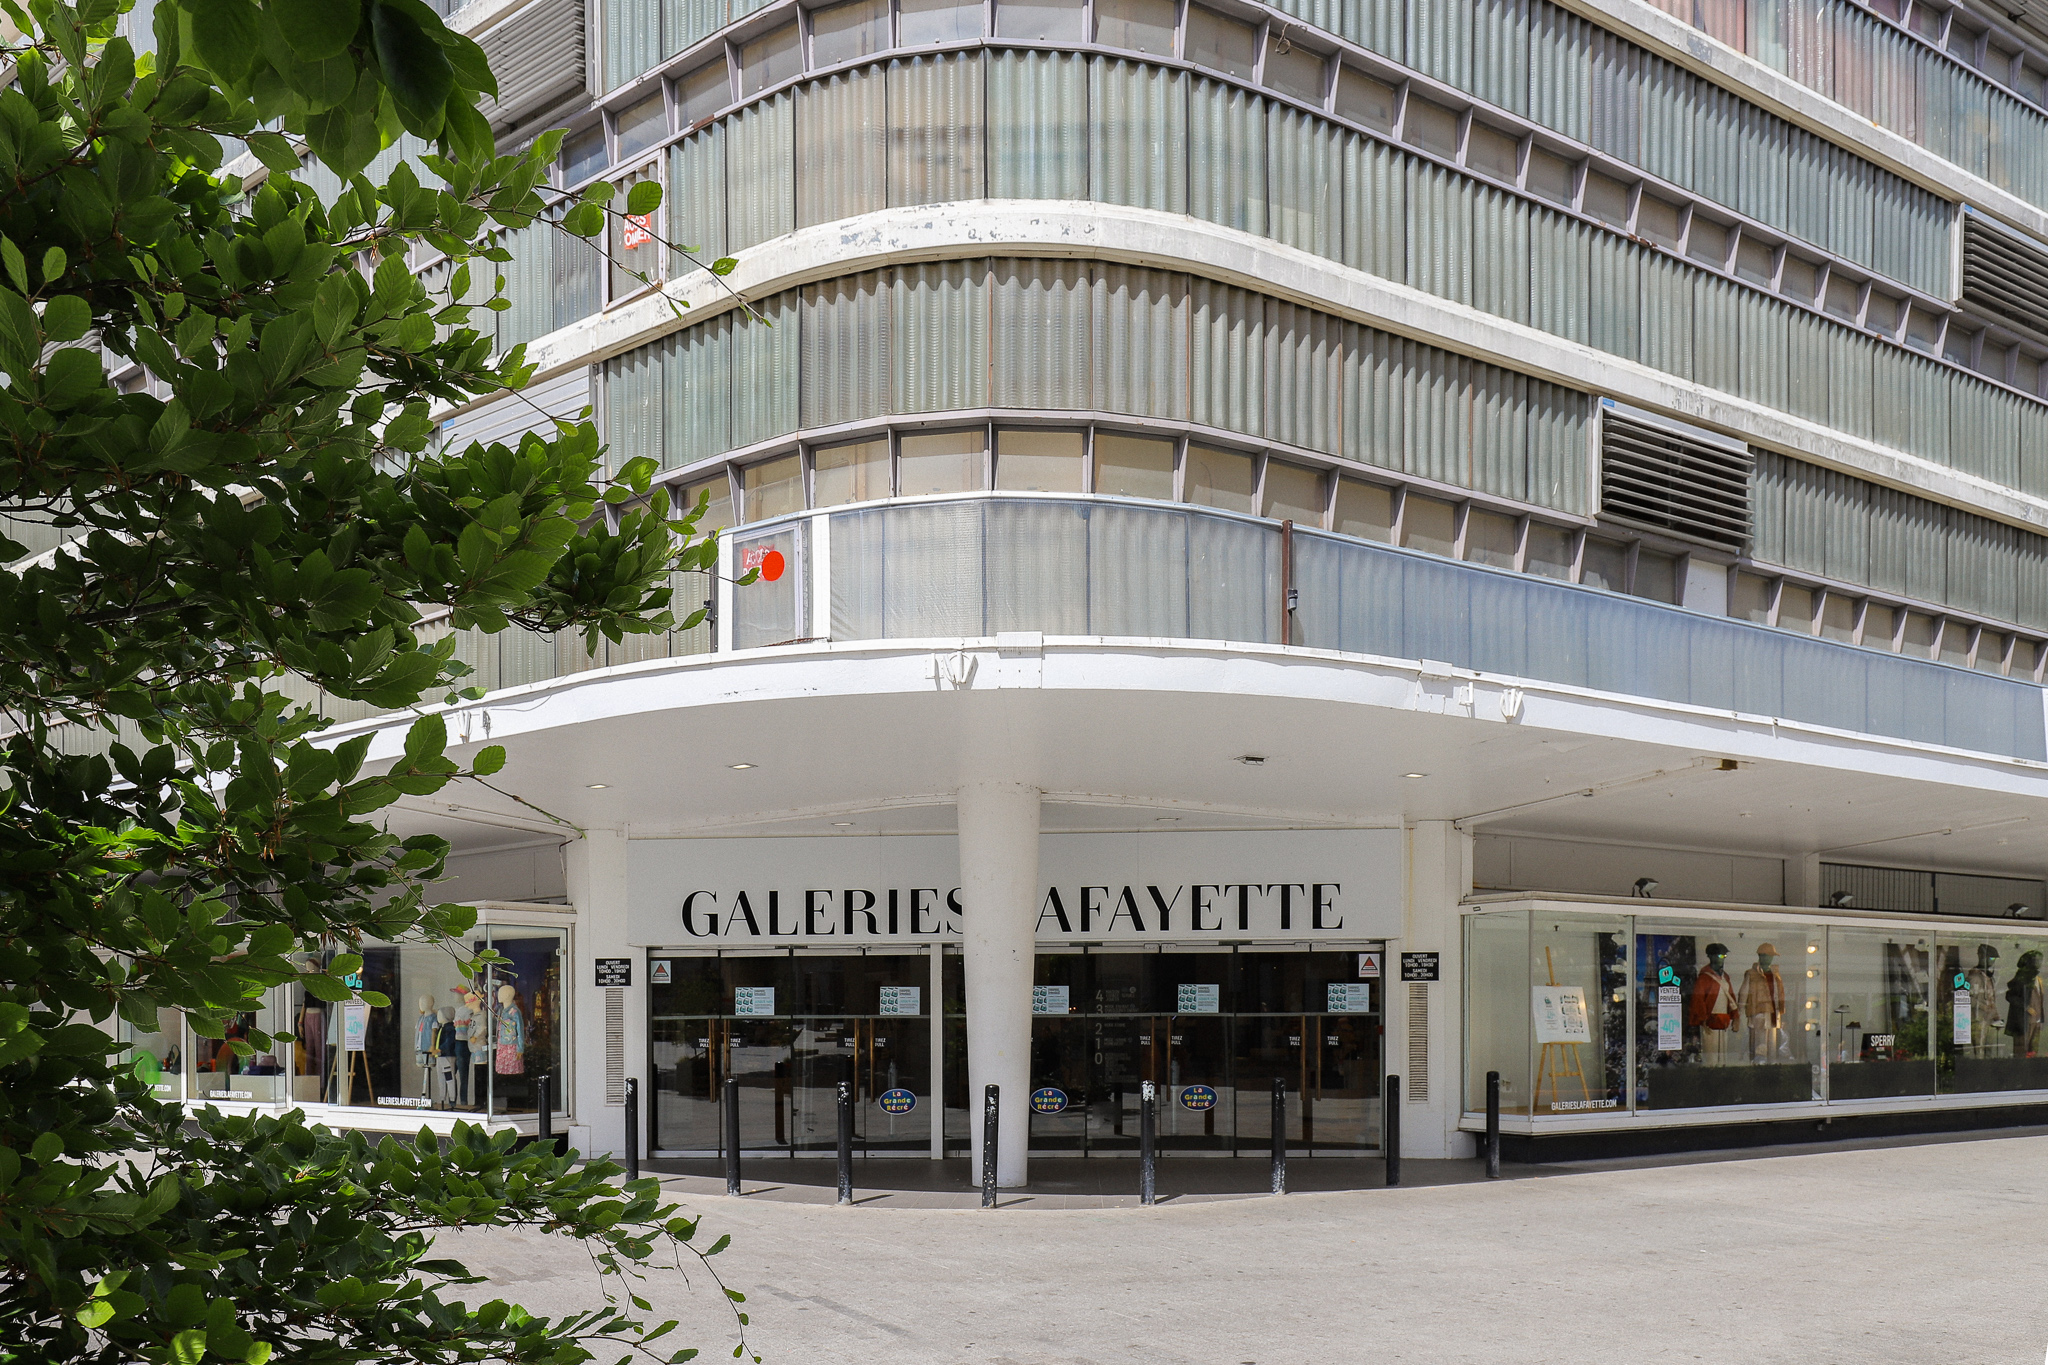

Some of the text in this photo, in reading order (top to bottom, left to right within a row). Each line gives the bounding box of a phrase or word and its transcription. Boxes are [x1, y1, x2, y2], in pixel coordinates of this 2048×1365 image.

[1035, 883, 1343, 933] AFAYETTE
[1096, 990, 1103, 1001] 4
[1096, 1004, 1103, 1015] 3
[1095, 1023, 1103, 1035] 2
[1095, 1038, 1100, 1049] 1
[1871, 1035, 1895, 1046] SPERRY
[1095, 1052, 1103, 1064] 0
[378, 1097, 431, 1107] GALERIESLAFAYETTE.COM
[1552, 1099, 1617, 1110] GALERIESLAFAYETTE.COM
